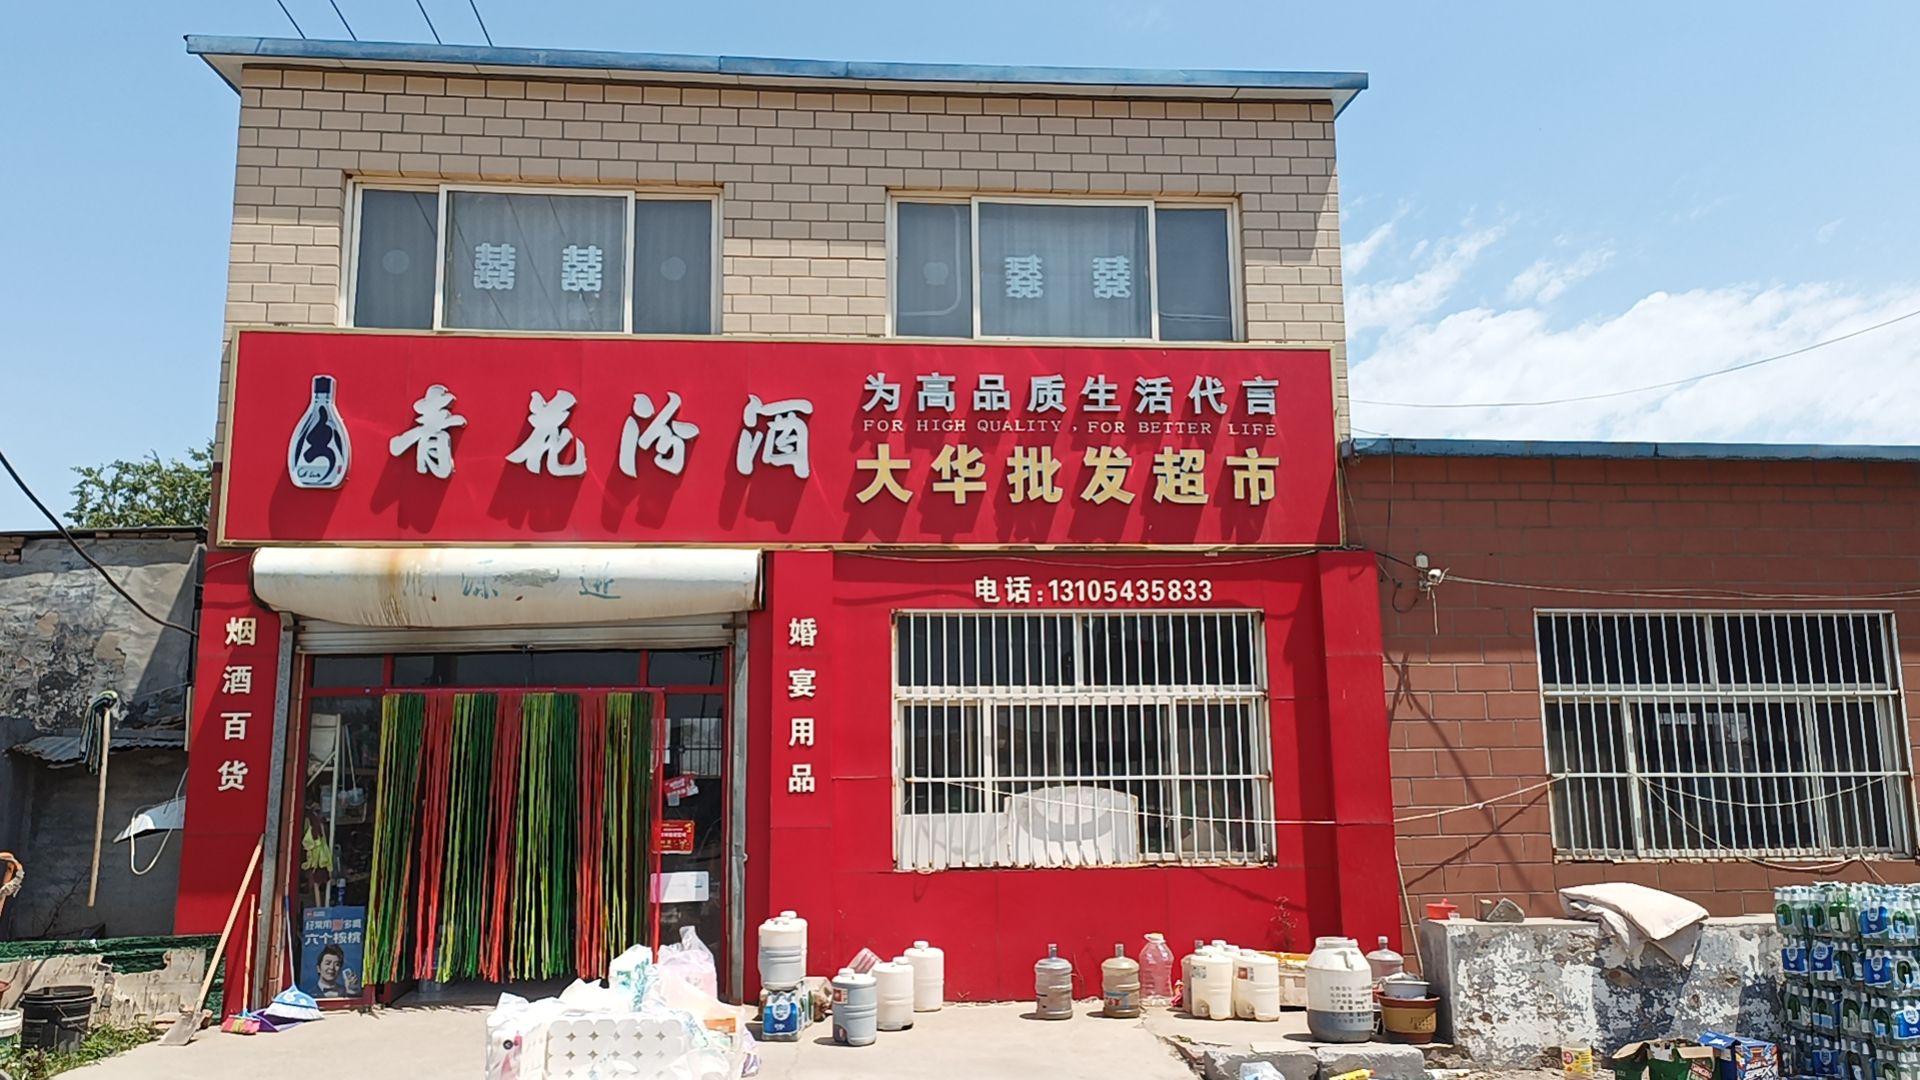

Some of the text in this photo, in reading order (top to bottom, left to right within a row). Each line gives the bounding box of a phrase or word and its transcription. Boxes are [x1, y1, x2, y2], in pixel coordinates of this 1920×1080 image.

[862, 373, 1279, 415] 为高品质生活代言
[389, 384, 814, 479] 青花汾酒
[863, 419, 904, 432] FOR
[916, 419, 967, 433] HIGH
[1087, 420, 1126, 434] FOR
[1138, 421, 1212, 435] BETTER
[1228, 423, 1277, 436] LIFE
[856, 443, 1280, 506] 大华批发超市
[217, 616, 257, 792] 烟酒百货
[788, 617, 818, 793] 婚宴用品
[304, 932, 361, 945] 六个核桃
